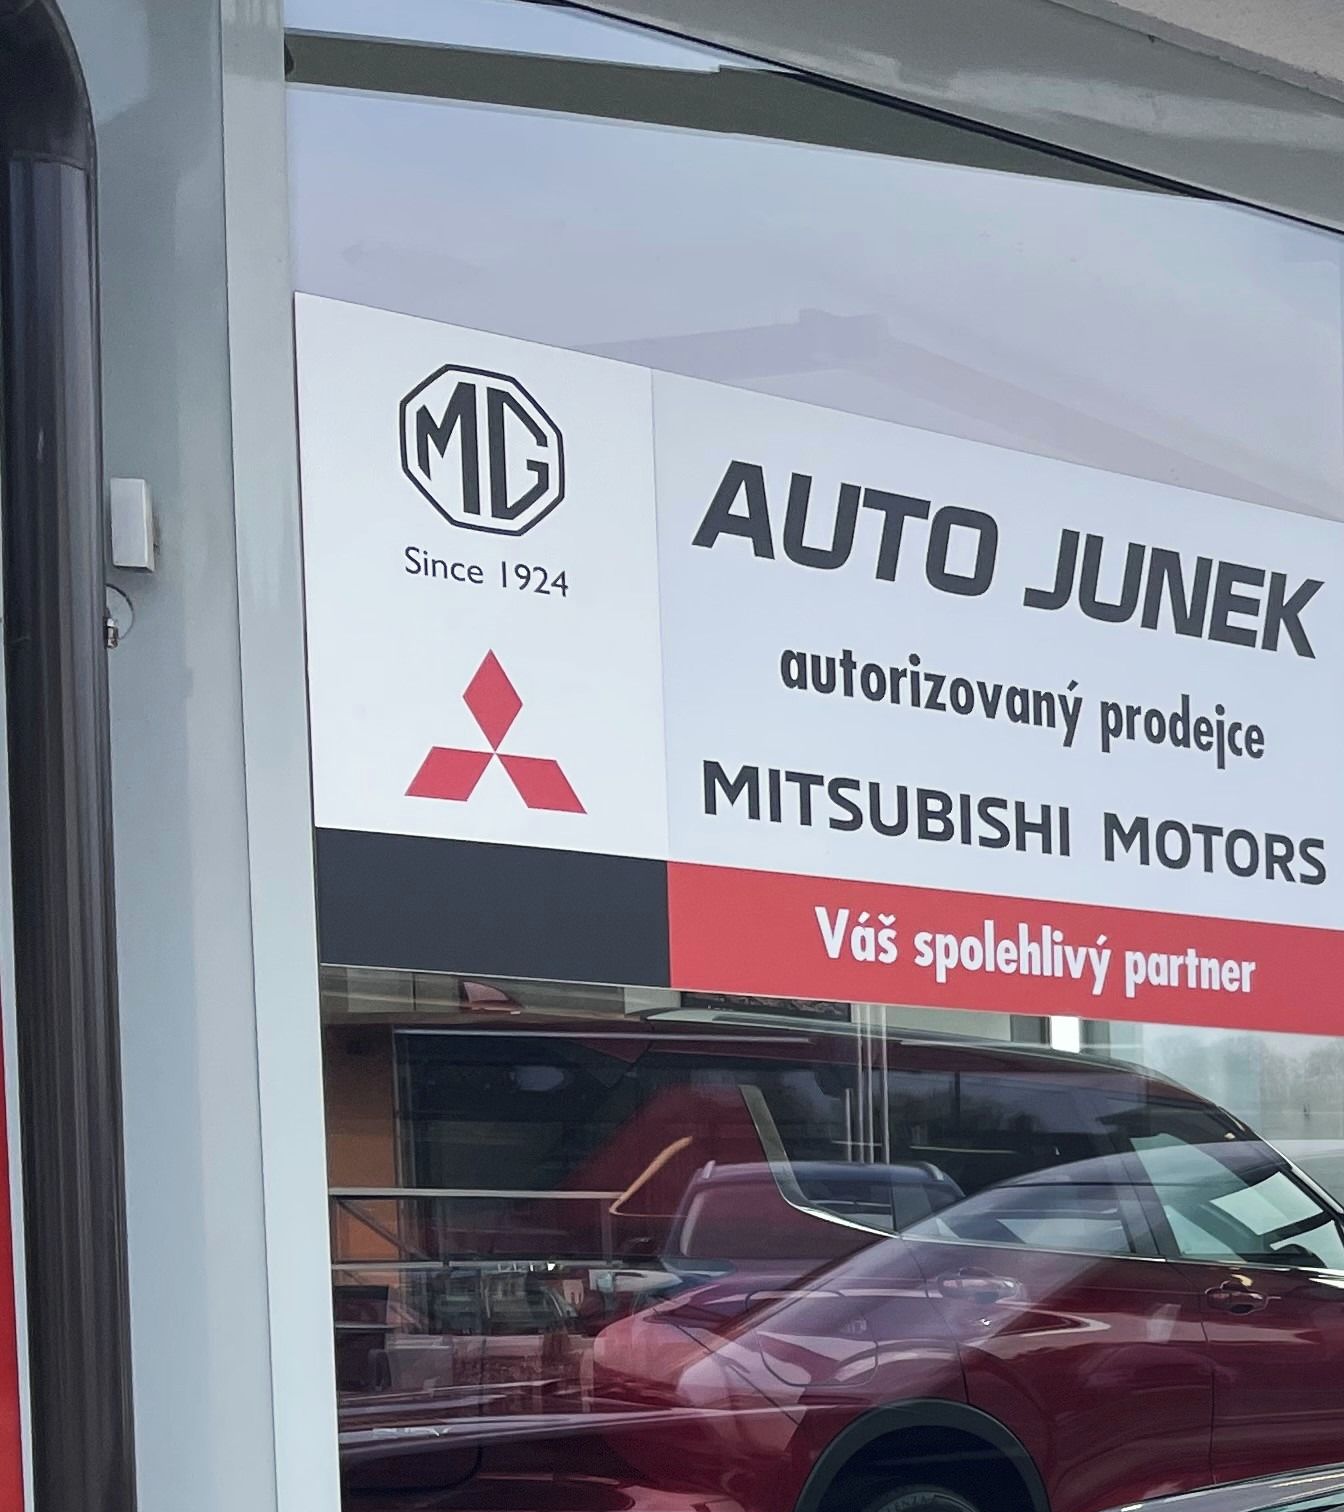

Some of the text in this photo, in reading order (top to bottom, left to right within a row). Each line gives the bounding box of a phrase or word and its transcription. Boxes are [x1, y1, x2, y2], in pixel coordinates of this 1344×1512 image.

[414, 380, 553, 523] MG
[404, 545, 570, 598] Since 1924
[691, 459, 1325, 660] AUTO JUNEK
[780, 647, 1266, 770] autorizovaný prodejce
[702, 759, 1328, 887] MITSUBISHI MOTORS
[814, 905, 1257, 998] Váš spolehlivý partner
